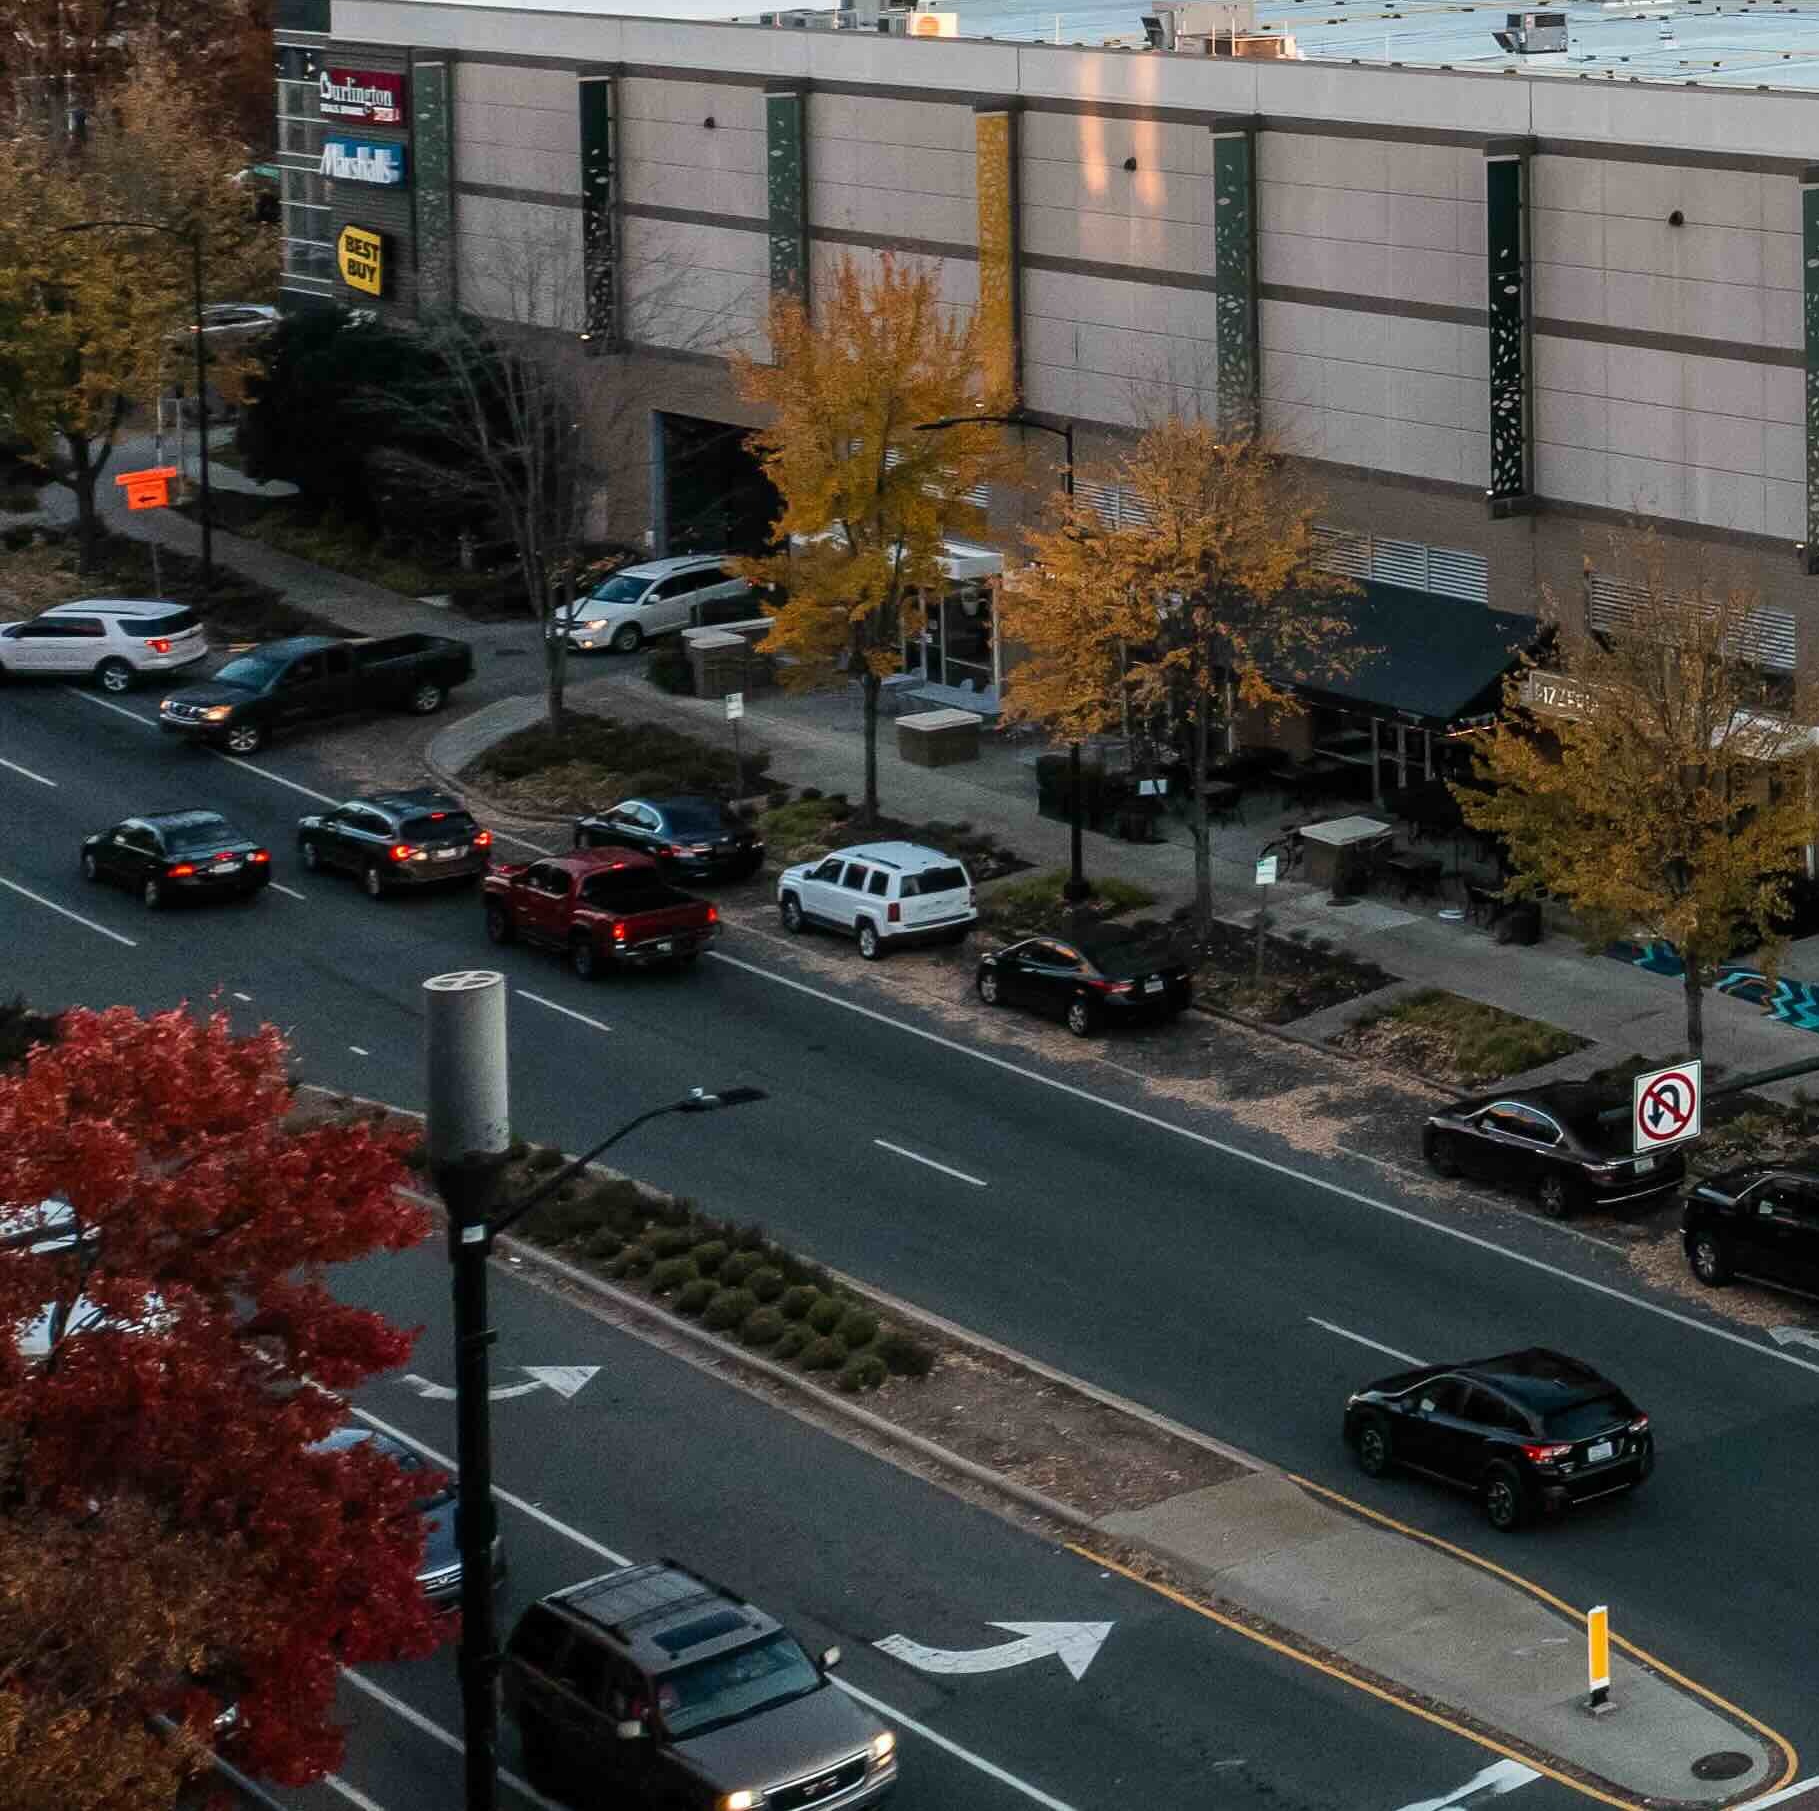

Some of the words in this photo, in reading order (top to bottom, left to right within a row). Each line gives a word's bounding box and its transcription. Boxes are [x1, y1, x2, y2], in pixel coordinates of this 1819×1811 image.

[320, 71, 393, 107] Burlington
[320, 143, 399, 183] Marshalls
[345, 235, 379, 262] BEST
[347, 258, 376, 283] BUY
